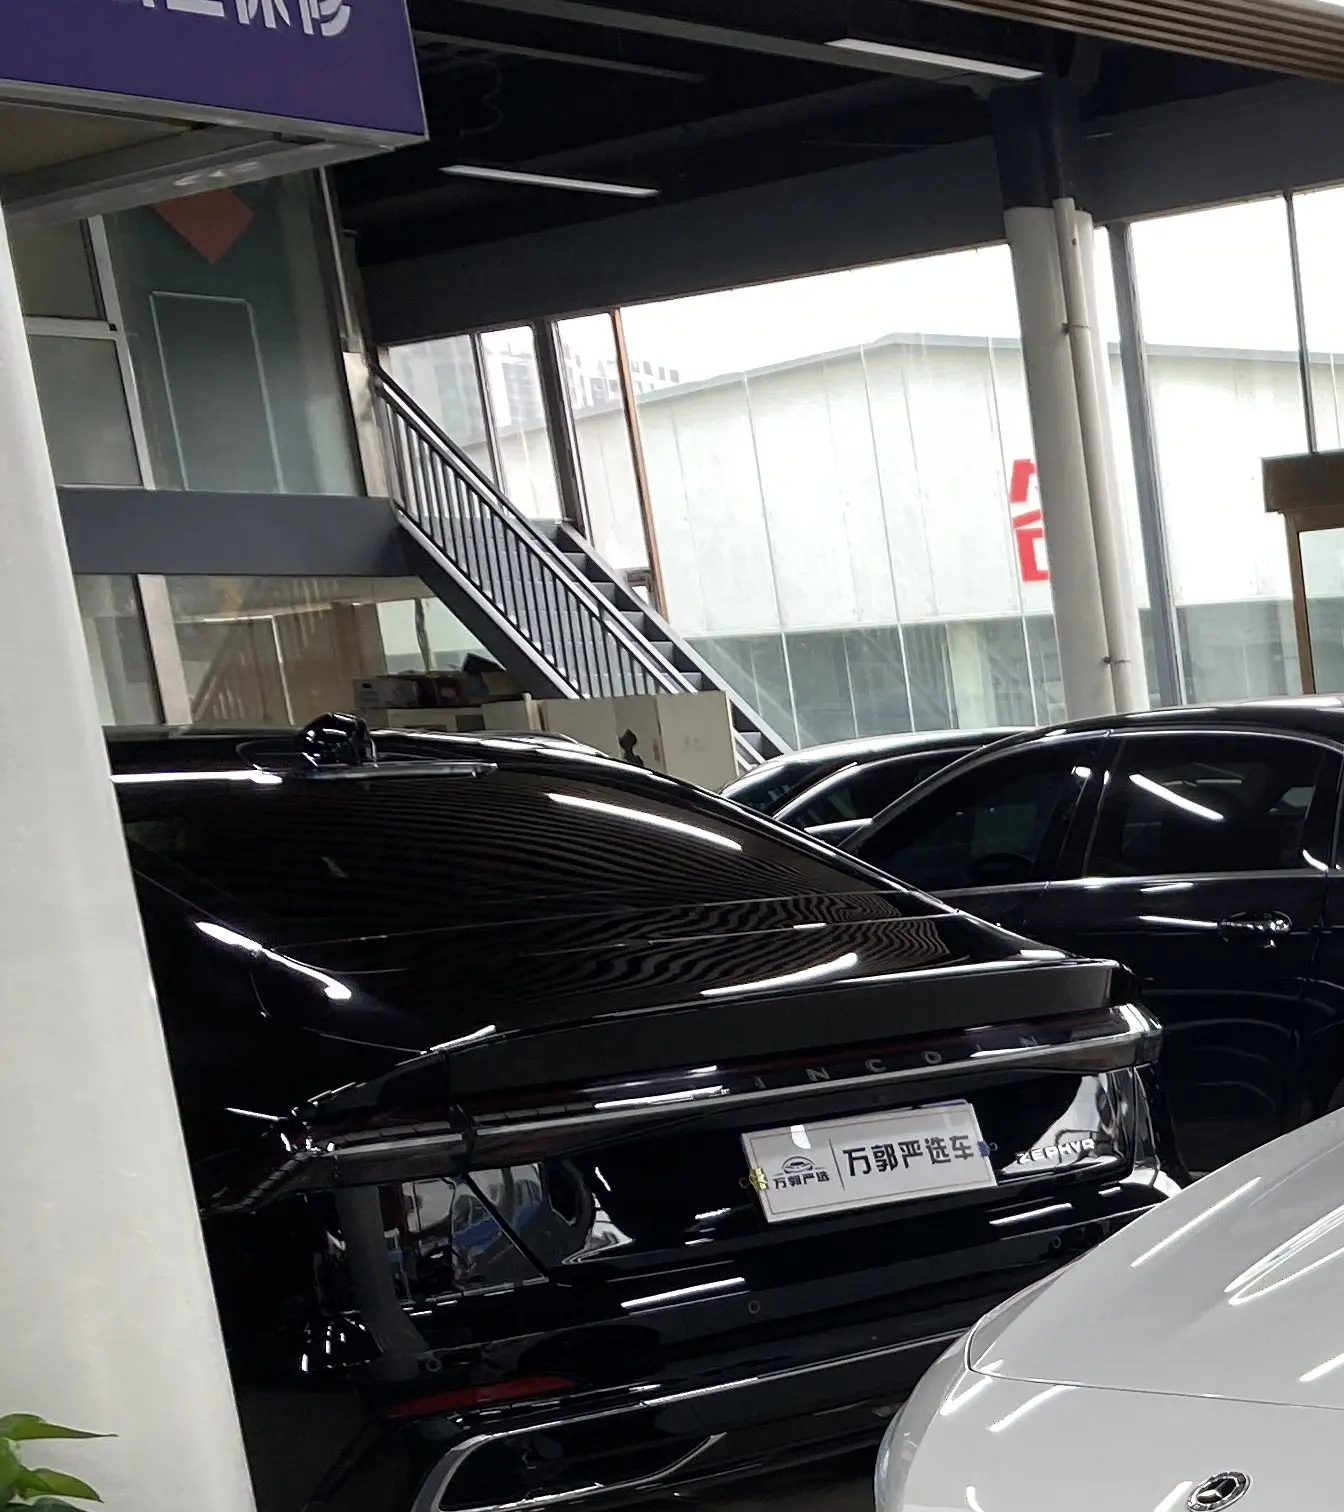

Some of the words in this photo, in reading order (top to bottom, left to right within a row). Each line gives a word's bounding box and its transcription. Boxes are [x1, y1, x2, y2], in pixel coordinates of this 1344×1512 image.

[842, 1134, 974, 1177] 万郭严选车
[1015, 1138, 1095, 1164] ZEPHYR
